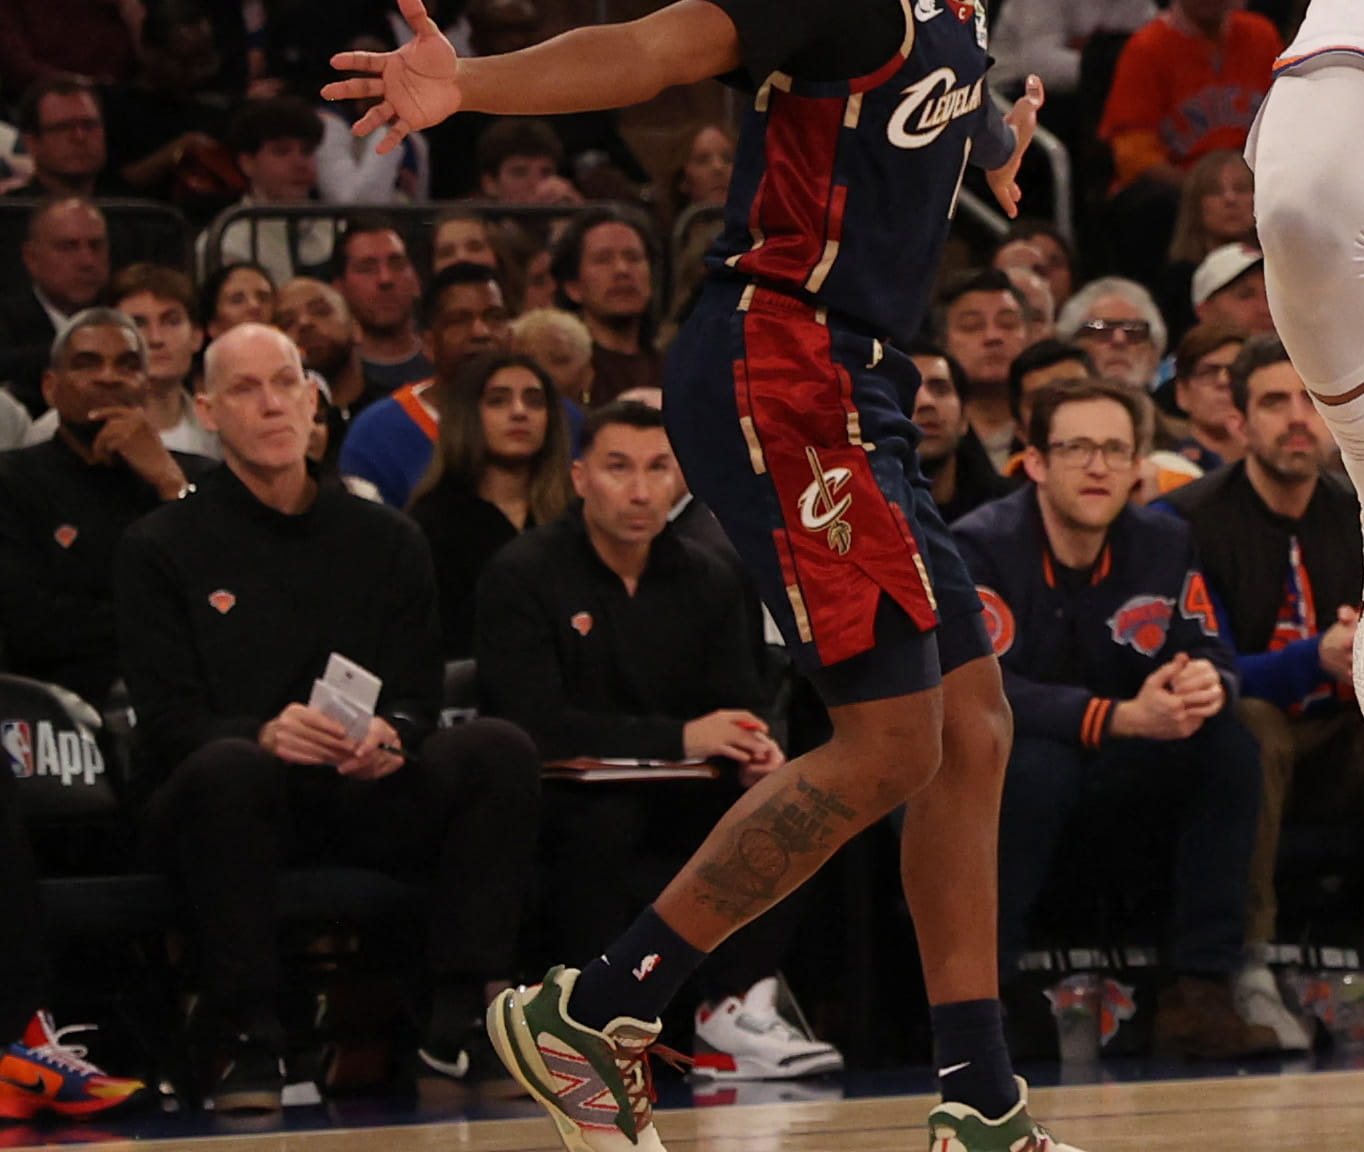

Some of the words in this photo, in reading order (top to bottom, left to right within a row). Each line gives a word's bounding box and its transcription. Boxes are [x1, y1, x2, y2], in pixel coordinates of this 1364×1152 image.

[886, 66, 985, 150] CLEVELA
[1180, 570, 1219, 637] 4
[36, 719, 106, 787] App
